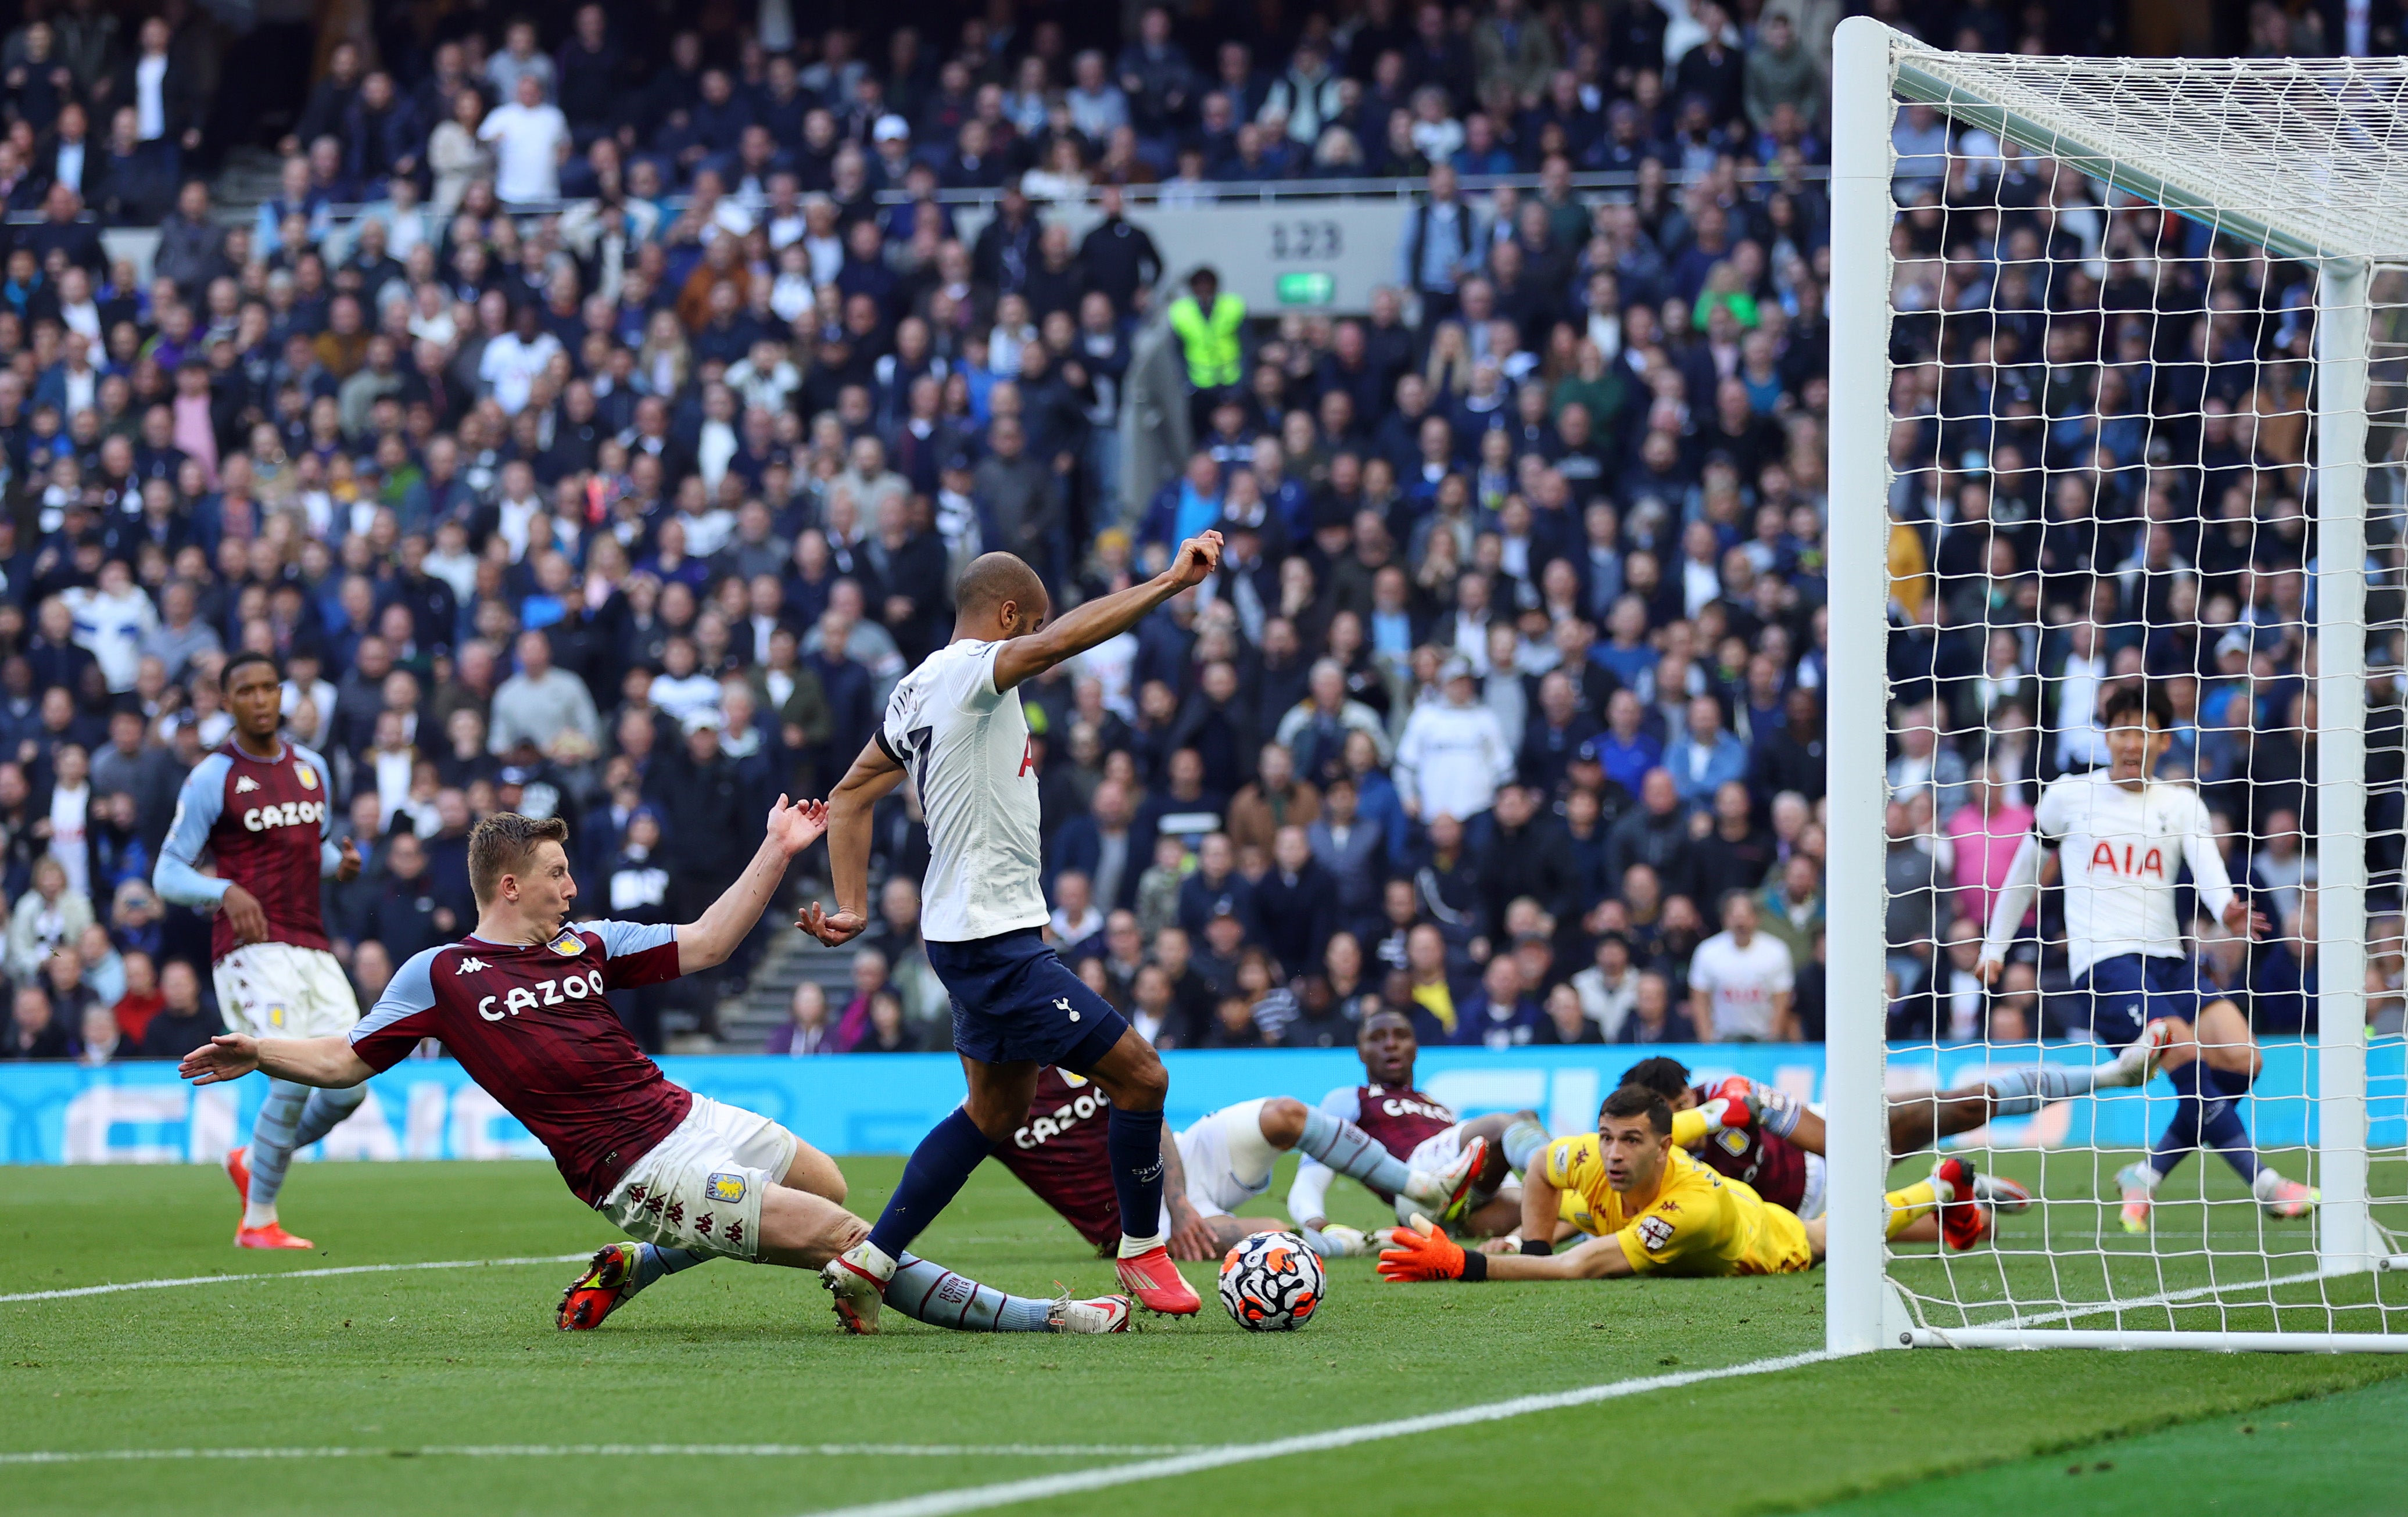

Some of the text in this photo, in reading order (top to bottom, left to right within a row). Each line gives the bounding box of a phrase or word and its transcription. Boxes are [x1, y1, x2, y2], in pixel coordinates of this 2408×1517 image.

[1270, 221, 1343, 260] 123
[2087, 841, 2164, 878] AIA
[478, 970, 603, 1021] CAZOO
[708, 1174, 718, 1197] AVFC
[938, 1276, 961, 1301] ASTON
